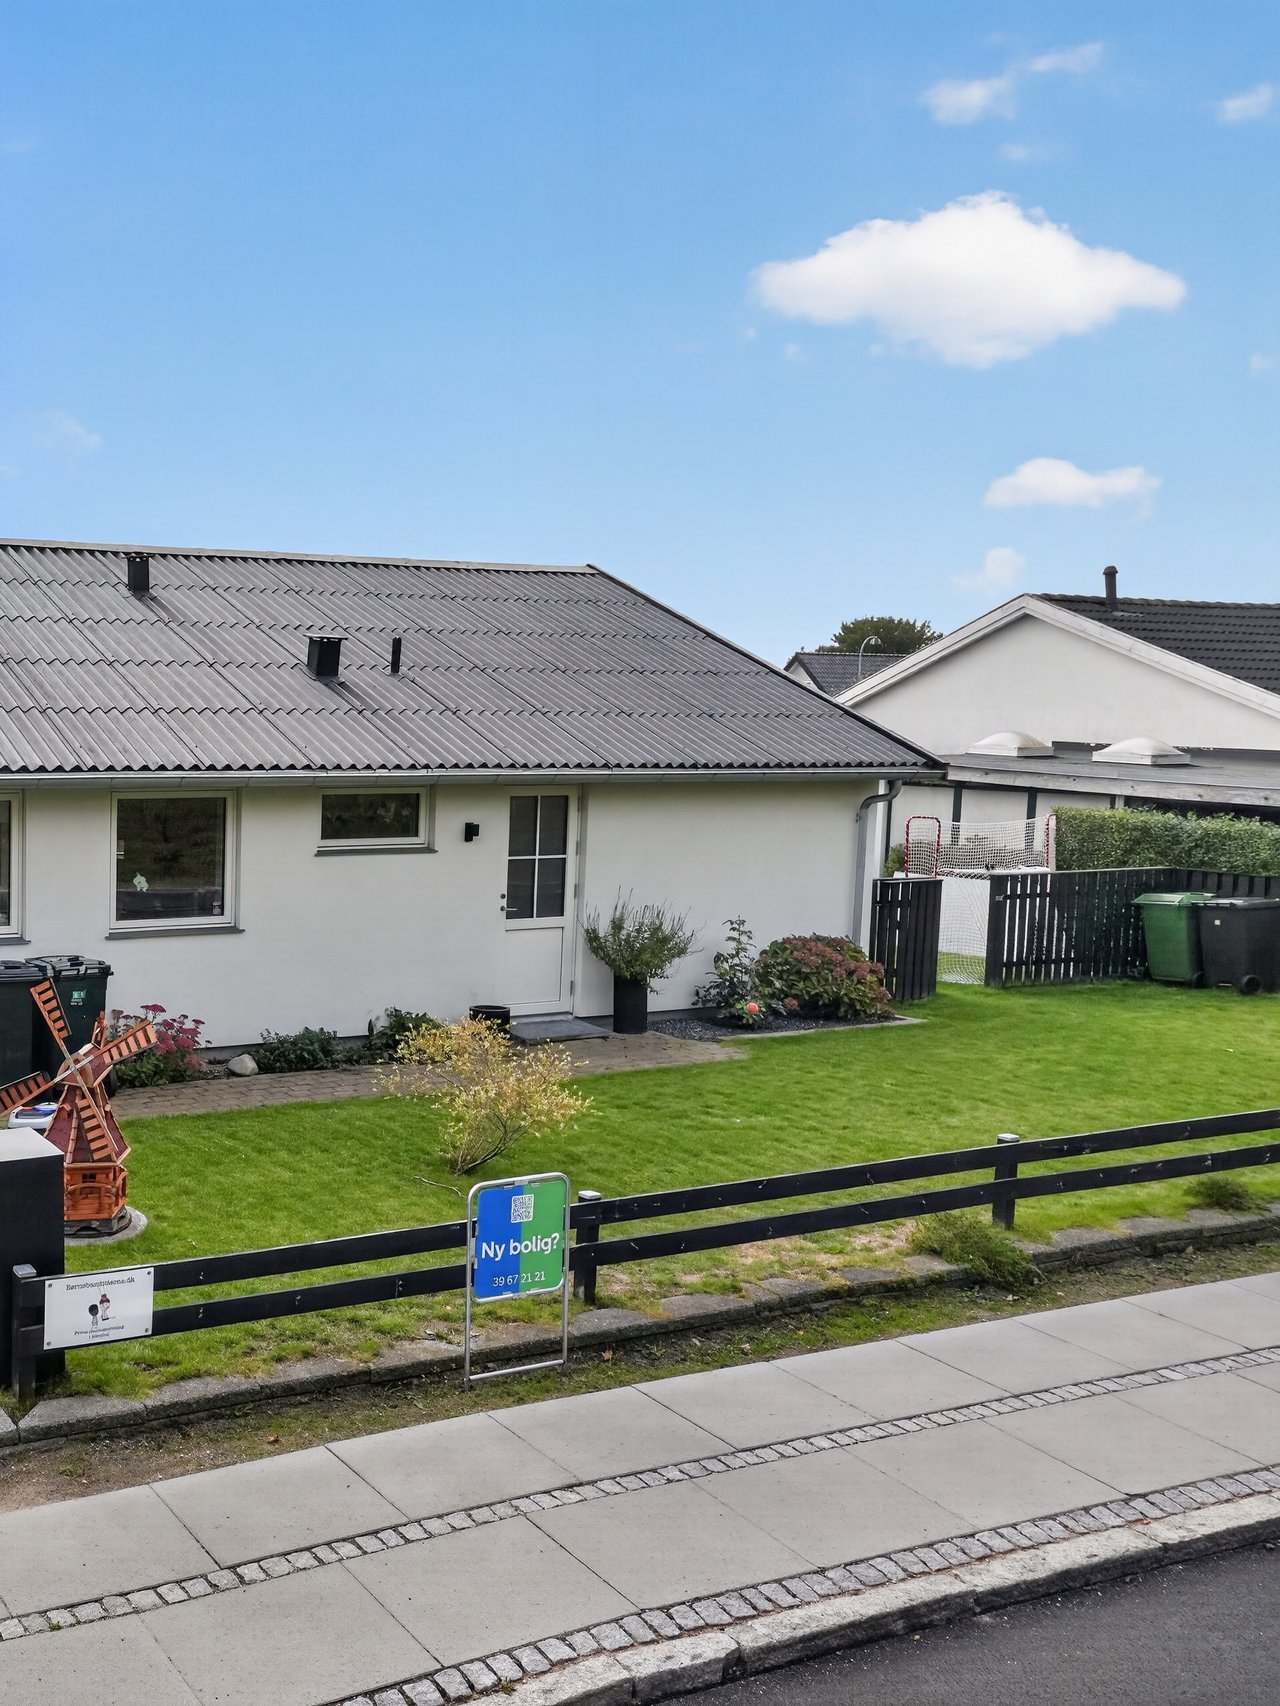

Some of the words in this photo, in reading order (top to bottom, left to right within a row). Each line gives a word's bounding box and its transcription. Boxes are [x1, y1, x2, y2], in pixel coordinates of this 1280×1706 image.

[481, 1241, 506, 1261] Ny
[509, 1232, 560, 1256] bolig?
[492, 1276, 505, 1287] 39
[506, 1274, 519, 1285] 67
[521, 1273, 532, 1283] 21
[534, 1270, 546, 1281] 21
